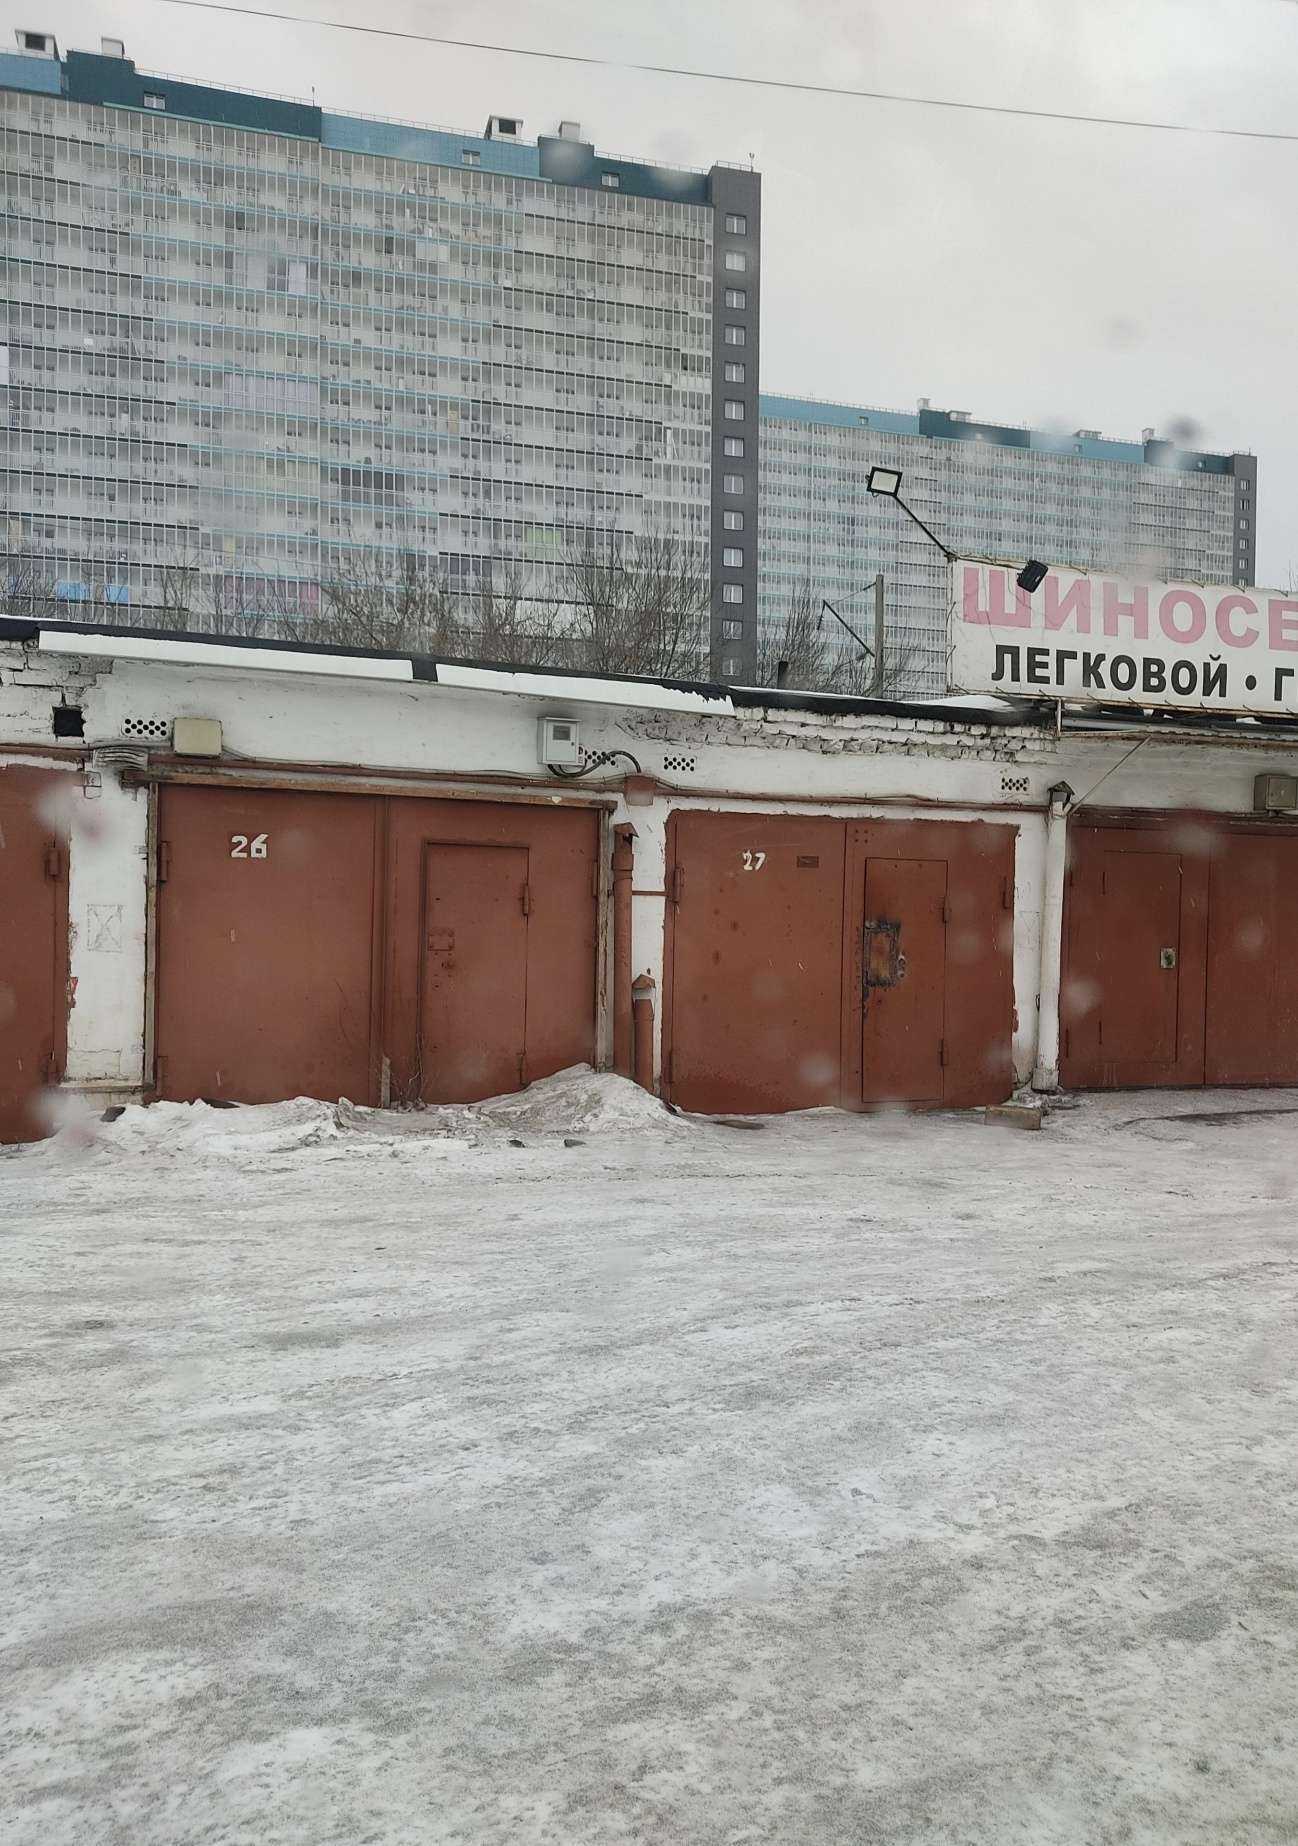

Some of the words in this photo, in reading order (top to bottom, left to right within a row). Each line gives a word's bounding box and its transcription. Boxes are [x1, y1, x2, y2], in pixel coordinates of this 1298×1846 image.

[963, 567, 1298, 651] ШИНОСЕ
[991, 644, 1228, 698] ЛЕГКОВОЙ
[231, 833, 269, 858] 26
[742, 849, 766, 871] 27
